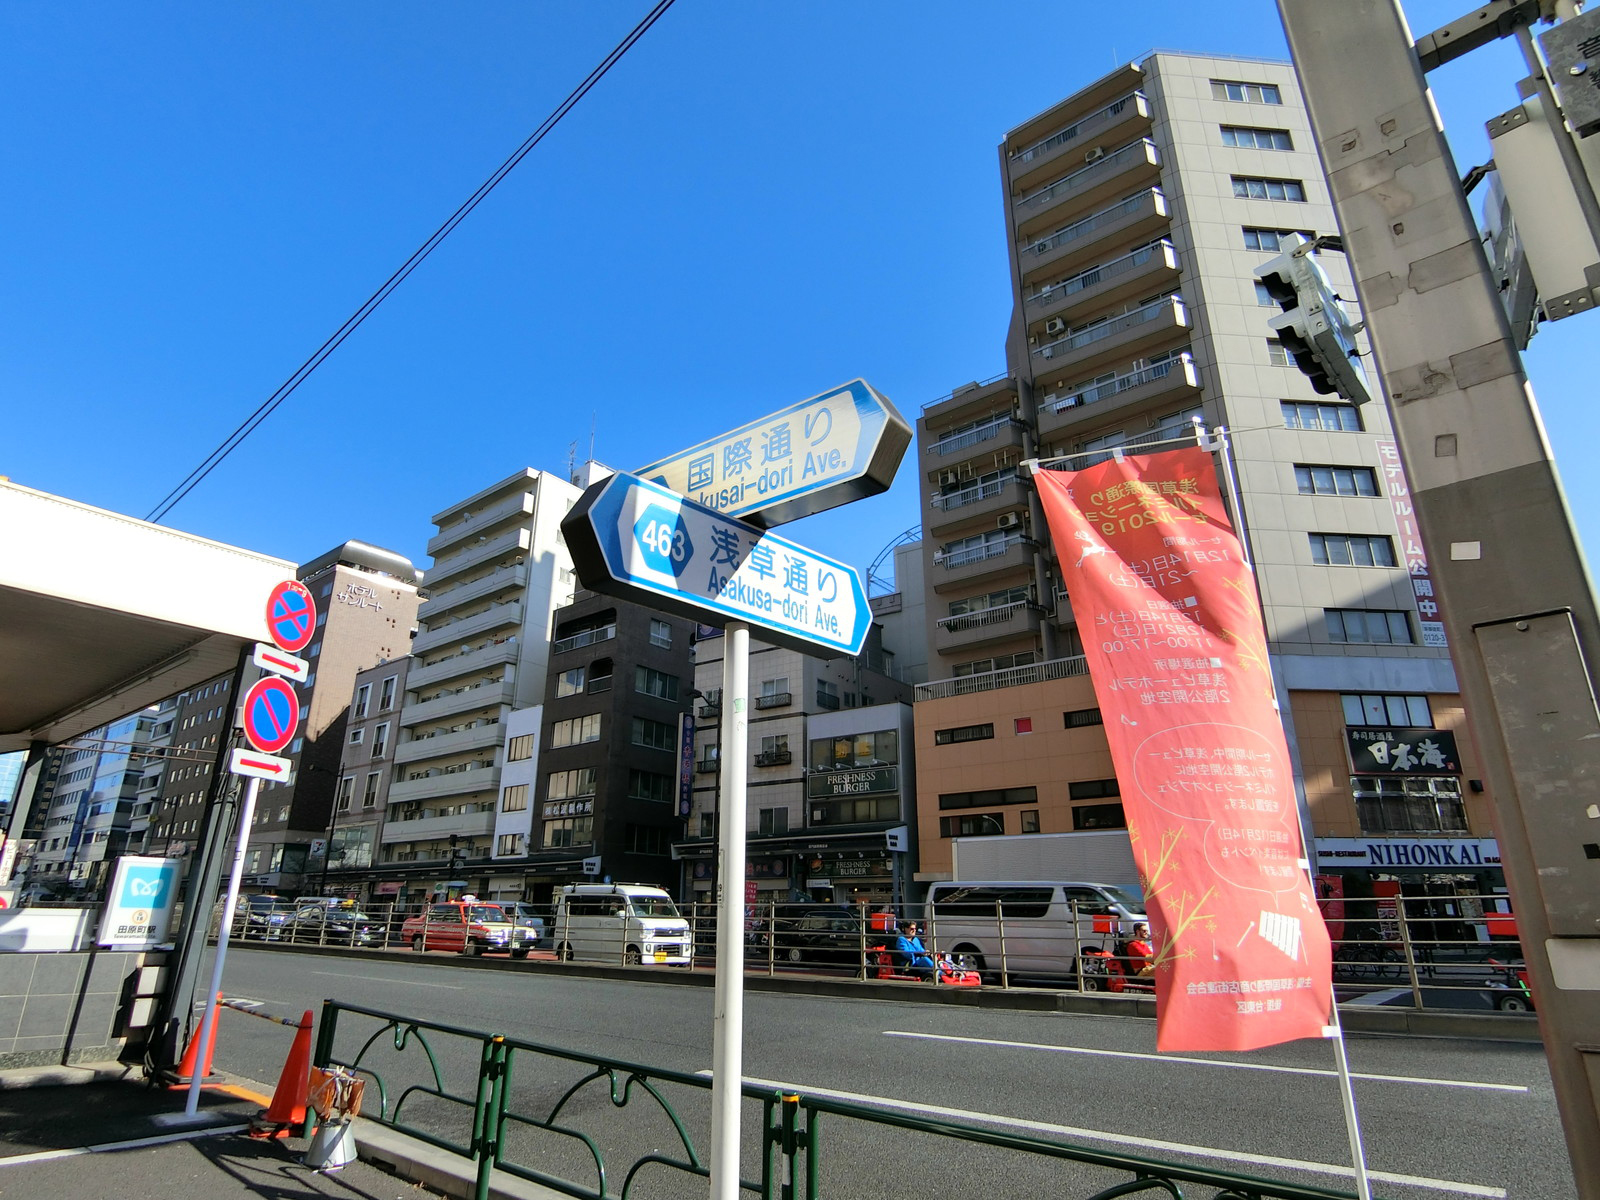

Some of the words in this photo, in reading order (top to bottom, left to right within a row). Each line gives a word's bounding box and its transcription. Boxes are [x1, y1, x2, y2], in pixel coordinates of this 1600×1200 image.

[688, 407, 832, 492] 国際通り
[693, 463, 793, 511] kusai-dori
[802, 448, 846, 480] Ave.
[642, 520, 685, 562] 463
[1381, 445, 1438, 617] モデルルーム公開中
[710, 526, 837, 603] 浅草通り
[346, 582, 378, 599] ホテル
[337, 591, 383, 612] サンルート
[708, 567, 808, 623] Asakusa-dori
[815, 604, 842, 637] Ave.
[1352, 730, 1394, 742] 寿司居酒屋
[1367, 738, 1447, 771] 日本海
[827, 771, 876, 785] FRESHNESS
[833, 782, 871, 794] BURGER
[836, 860, 871, 869] FRESHNESS
[1367, 844, 1483, 865] NIHONKAI
[840, 868, 867, 876] BURGER
[118, 925, 157, 934] 田原町駅
